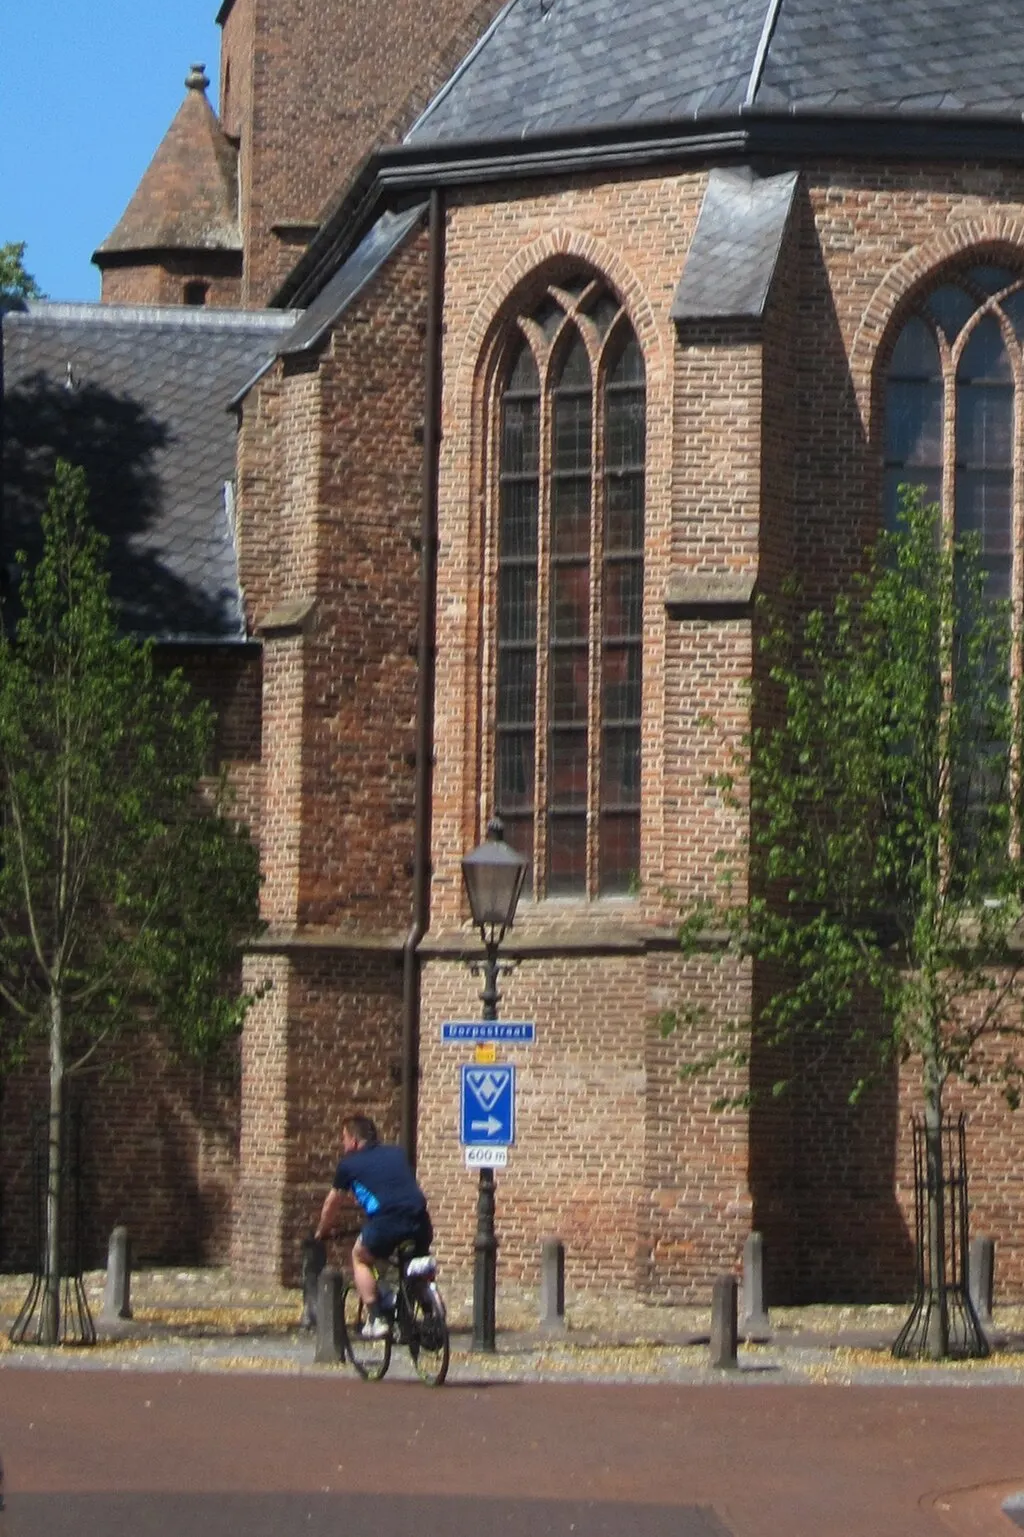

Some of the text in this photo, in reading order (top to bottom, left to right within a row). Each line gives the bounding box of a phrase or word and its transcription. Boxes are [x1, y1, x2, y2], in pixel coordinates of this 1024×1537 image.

[448, 1024, 527, 1039] Dorpsstraat
[468, 1148, 506, 1162] 600 m
